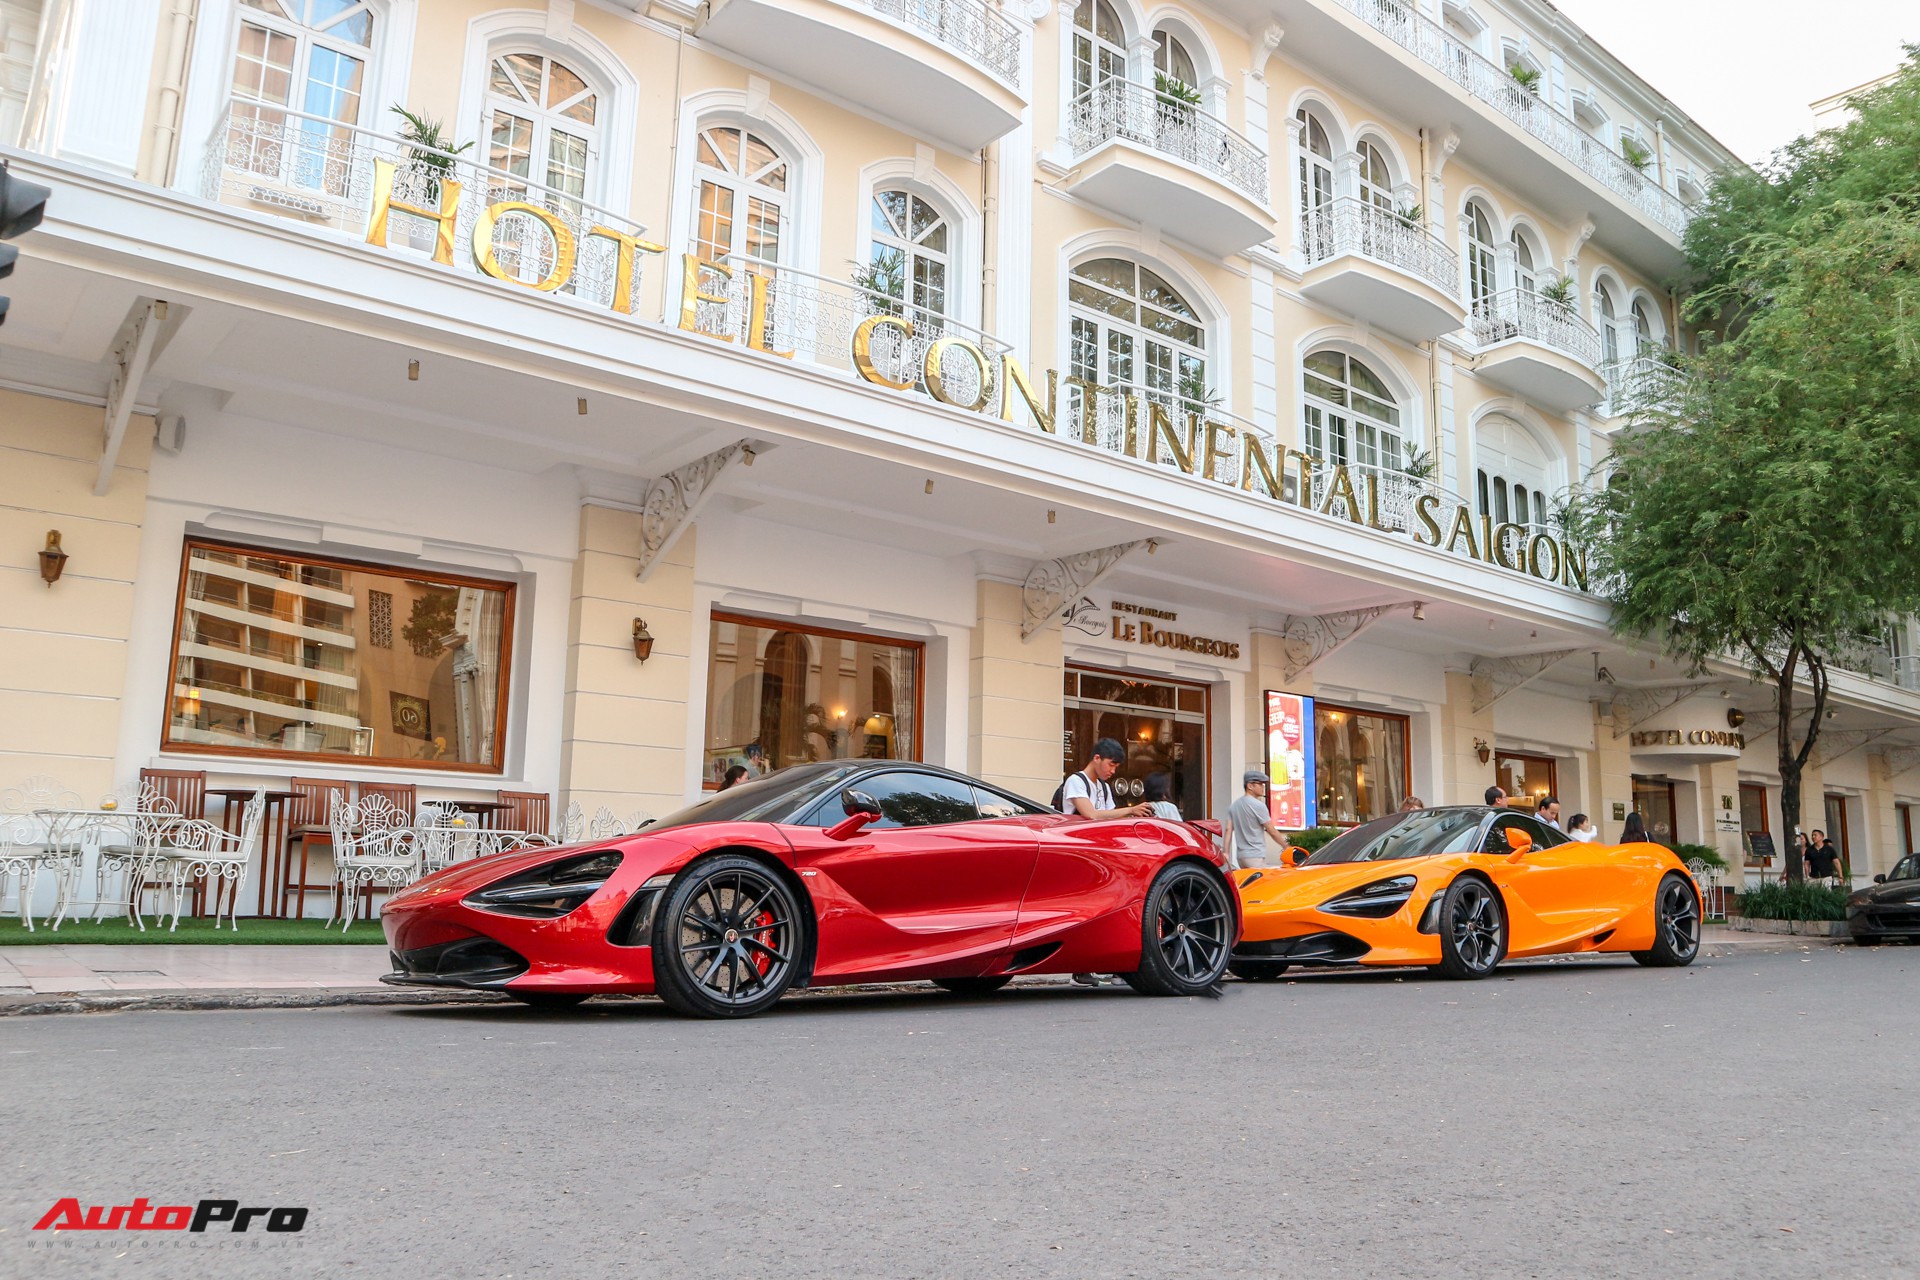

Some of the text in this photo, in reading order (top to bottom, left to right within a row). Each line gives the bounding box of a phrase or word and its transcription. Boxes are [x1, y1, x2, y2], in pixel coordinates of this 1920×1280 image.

[365, 157, 1588, 592] HOTEL CONTINENTAL SAIGON
[1112, 600, 1178, 621] RESTAURANT
[1630, 729, 1687, 746] HOTEL
